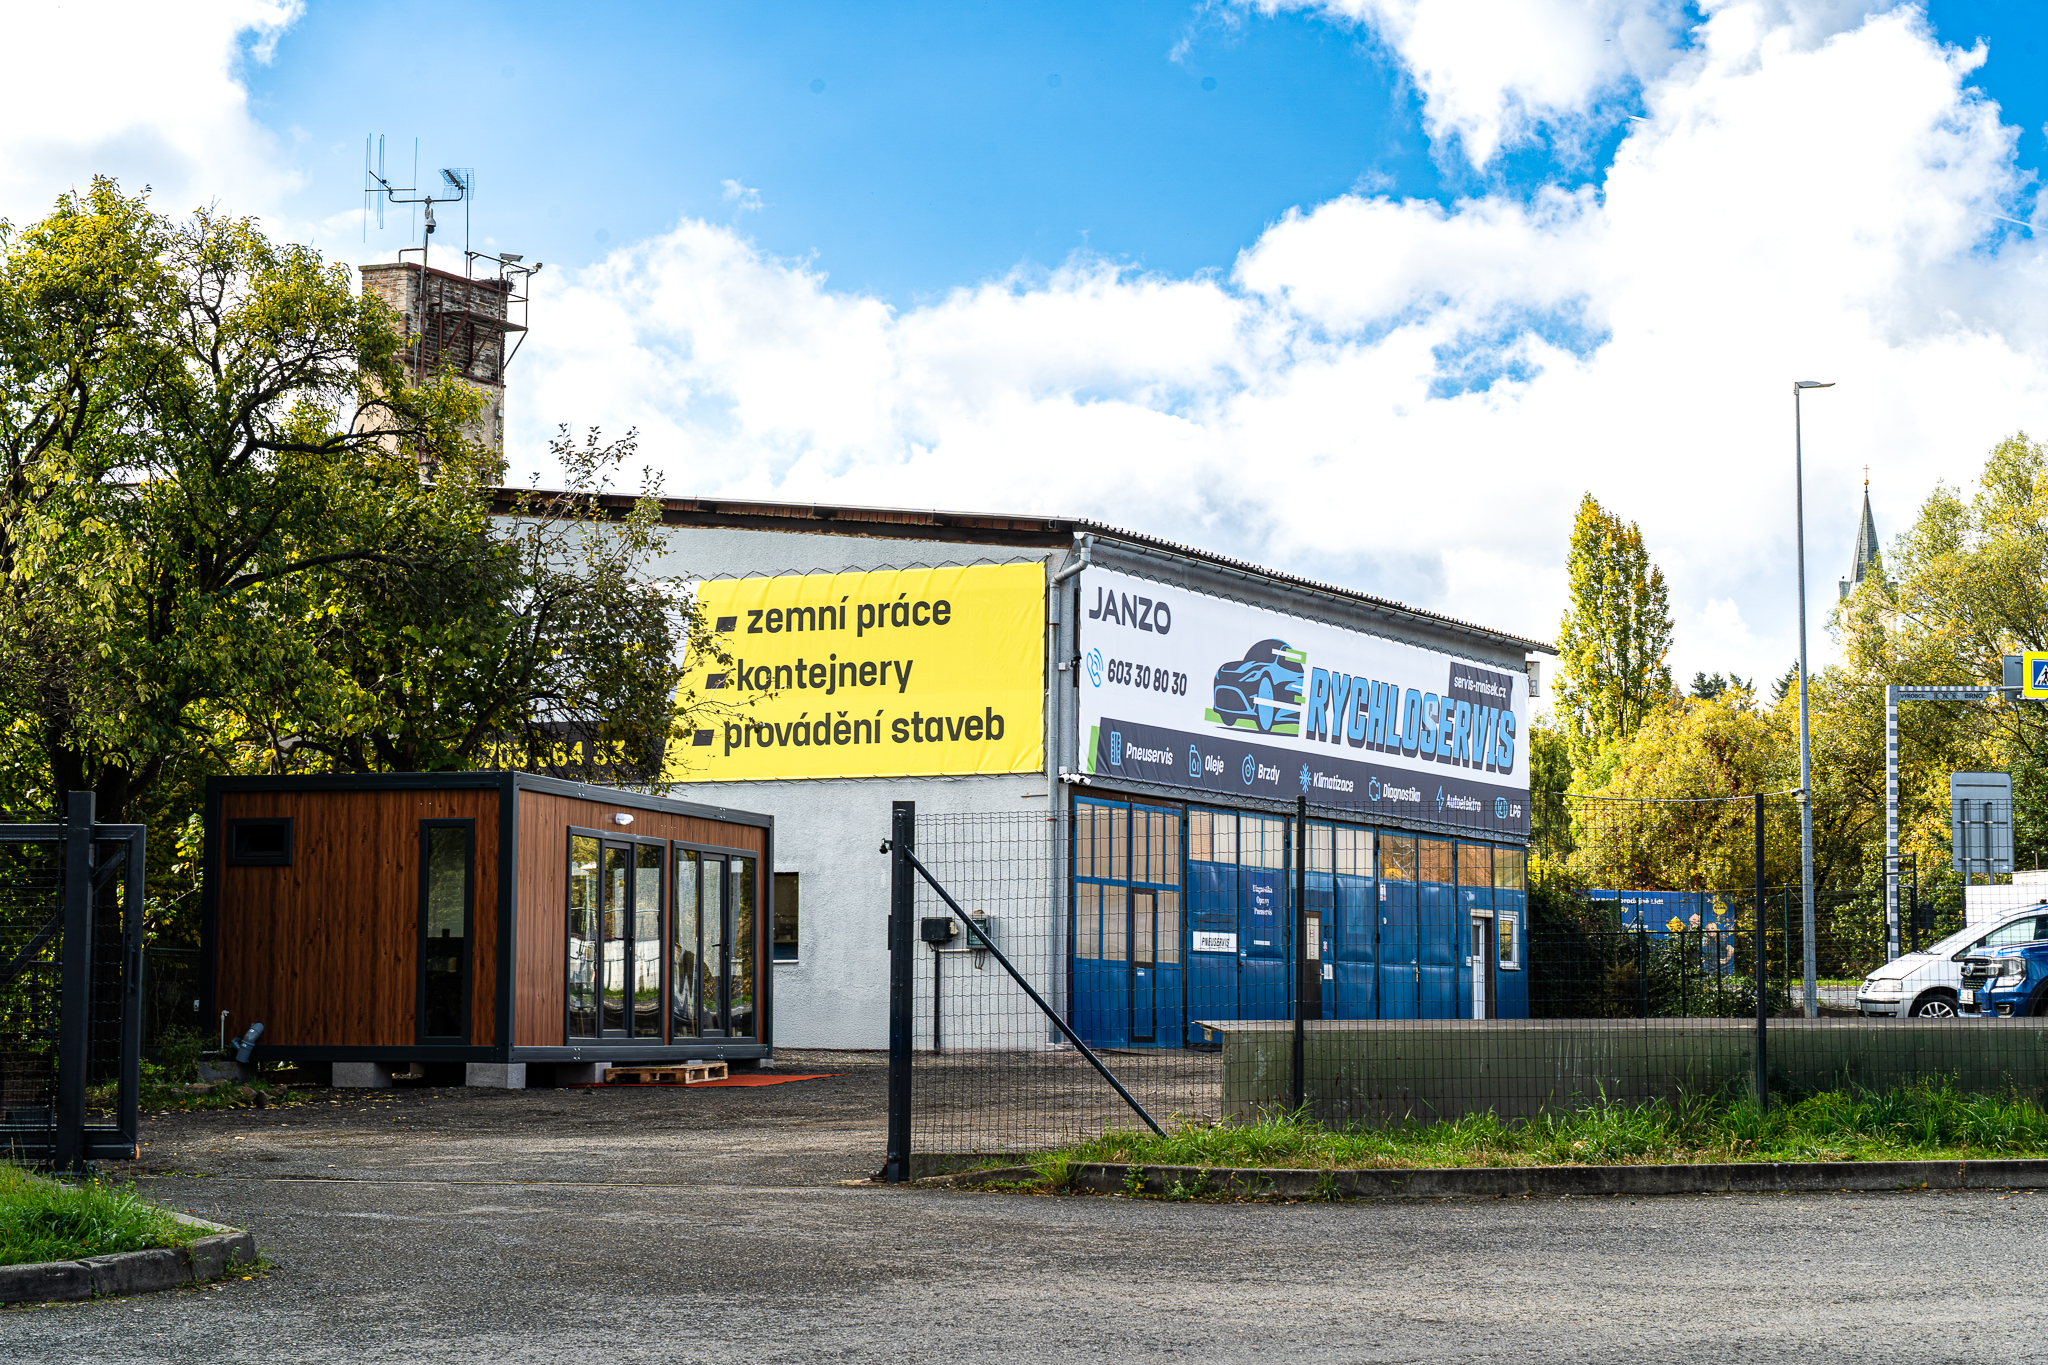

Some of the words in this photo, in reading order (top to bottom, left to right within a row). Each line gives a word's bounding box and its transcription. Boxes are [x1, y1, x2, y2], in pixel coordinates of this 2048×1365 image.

[747, 595, 849, 633] zemní
[856, 592, 951, 637] práce
[1088, 586, 1171, 635] JANZO
[737, 653, 914, 695] kontejnery
[1107, 658, 1133, 686] 603
[1134, 663, 1151, 690] 30
[1153, 667, 1170, 693] 80
[1171, 671, 1188, 697] 30
[1453, 675, 1507, 698] servis-mnisek.cz
[723, 709, 884, 757] provádění
[891, 706, 1005, 744] staveb
[1306, 666, 1516, 776] RYCHLOSERVIS
[1125, 742, 1174, 766] Pneuservis
[1204, 754, 1225, 774] Oleje
[1257, 763, 1281, 785] Brzdy
[1312, 772, 1354, 793] Klimatizace
[1382, 783, 1421, 802] Diagnostika
[1509, 803, 1522, 819] LPG
[1202, 937, 1230, 947] PNEUSERVIS
